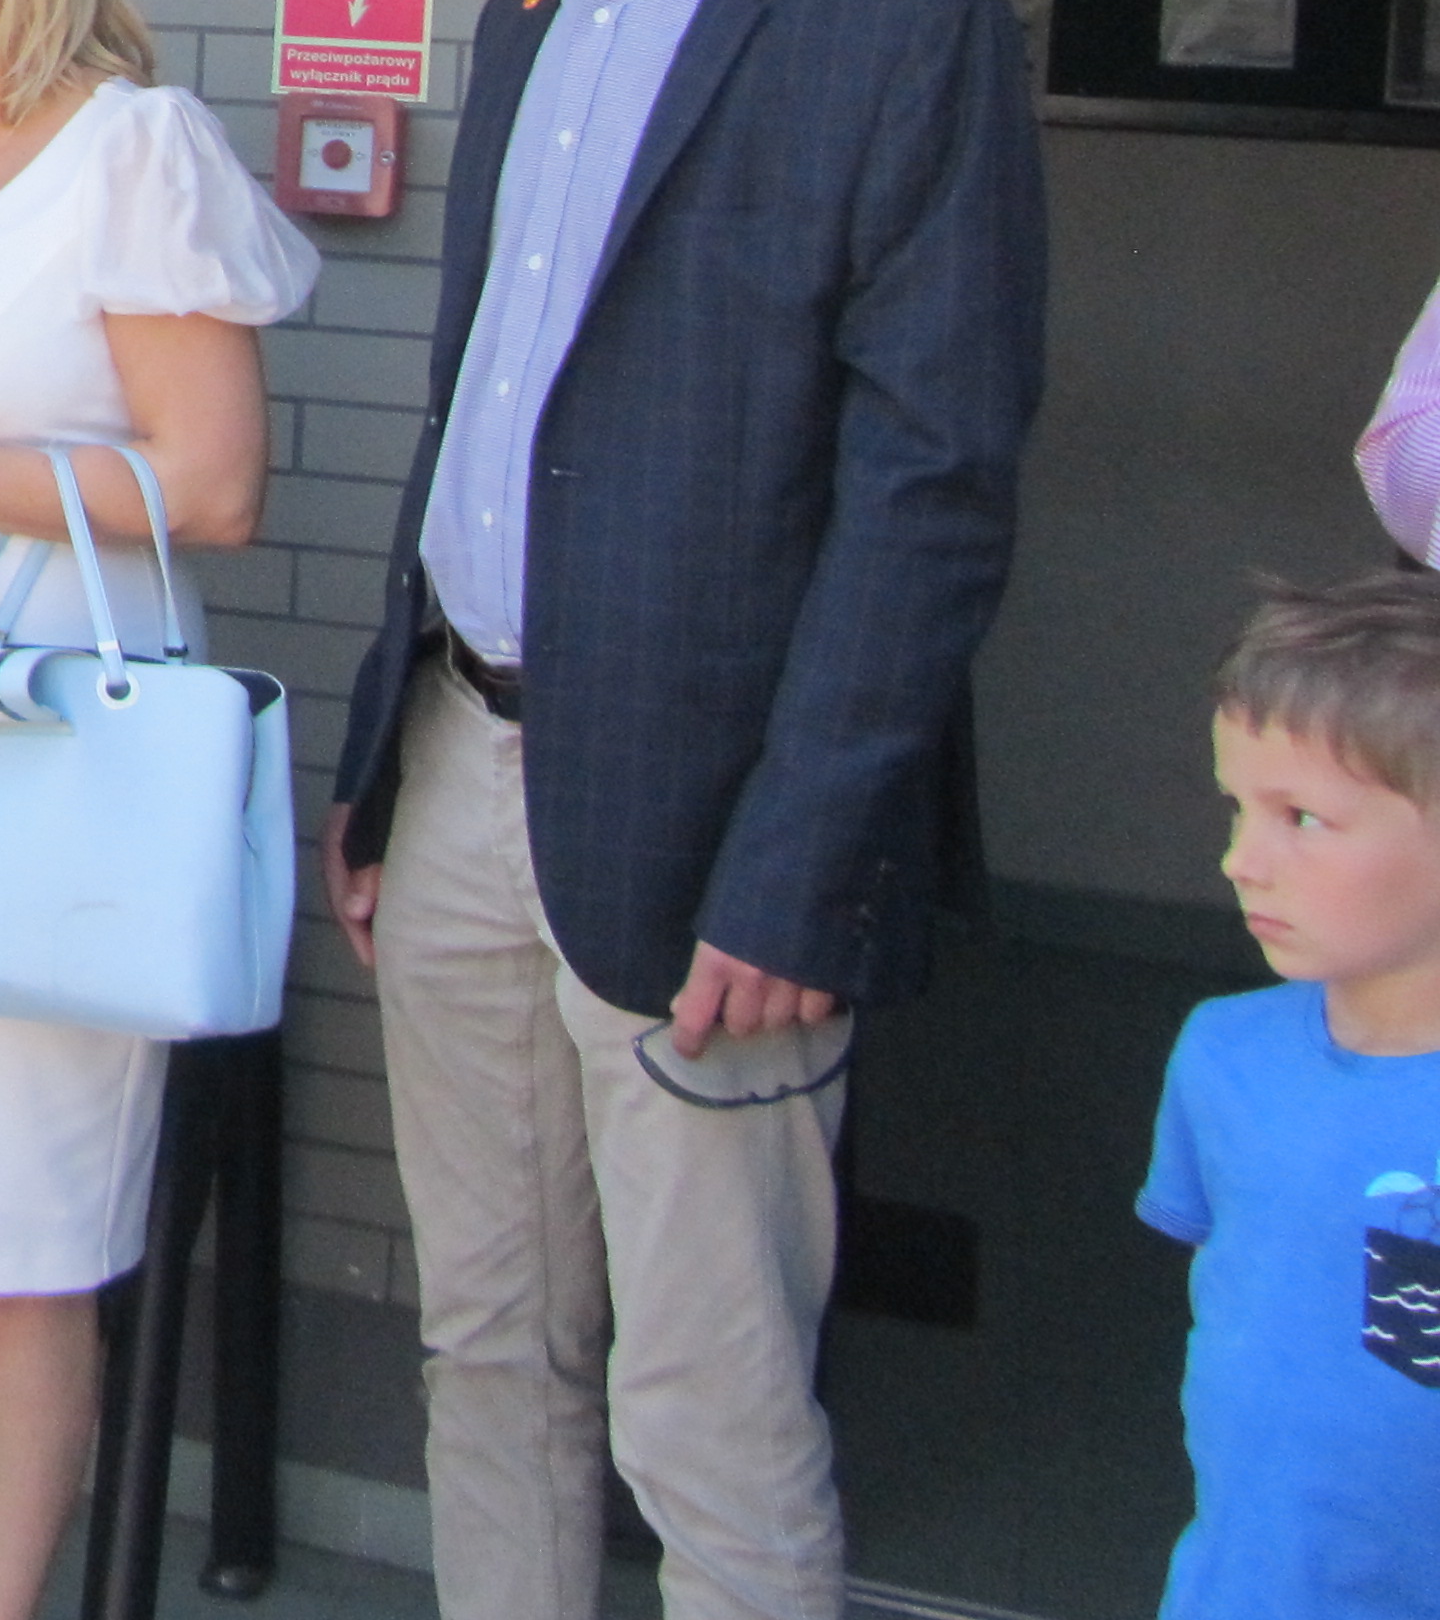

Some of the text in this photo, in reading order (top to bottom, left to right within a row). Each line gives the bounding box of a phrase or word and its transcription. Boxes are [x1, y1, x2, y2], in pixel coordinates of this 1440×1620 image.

[286, 48, 416, 70] Przeciwpożarowy
[290, 69, 410, 88] wyłącznik prądu
